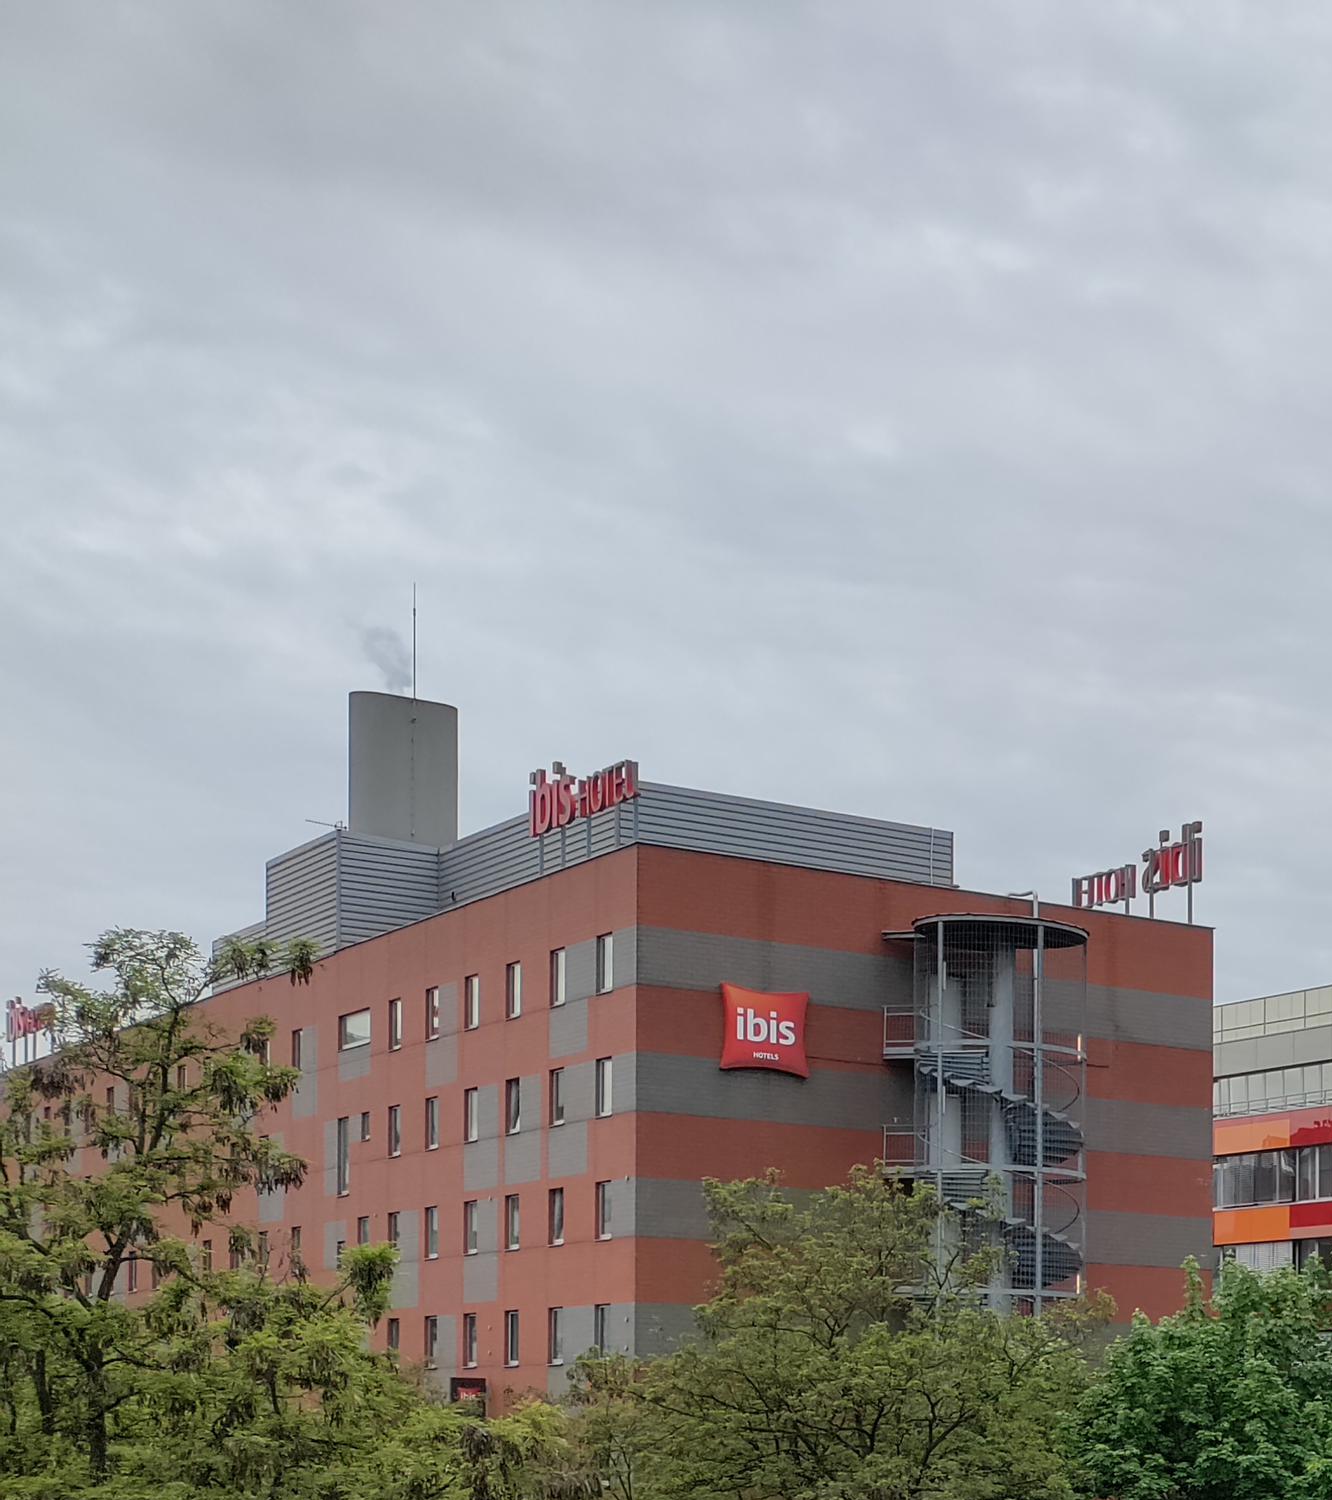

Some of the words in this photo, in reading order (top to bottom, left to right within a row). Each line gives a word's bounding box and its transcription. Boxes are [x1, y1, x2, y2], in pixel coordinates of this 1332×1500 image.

[529, 761, 577, 837] ibis
[577, 759, 640, 818] HOTEL
[736, 1007, 796, 1046] ibis
[753, 1052, 779, 1060] HOTELS
